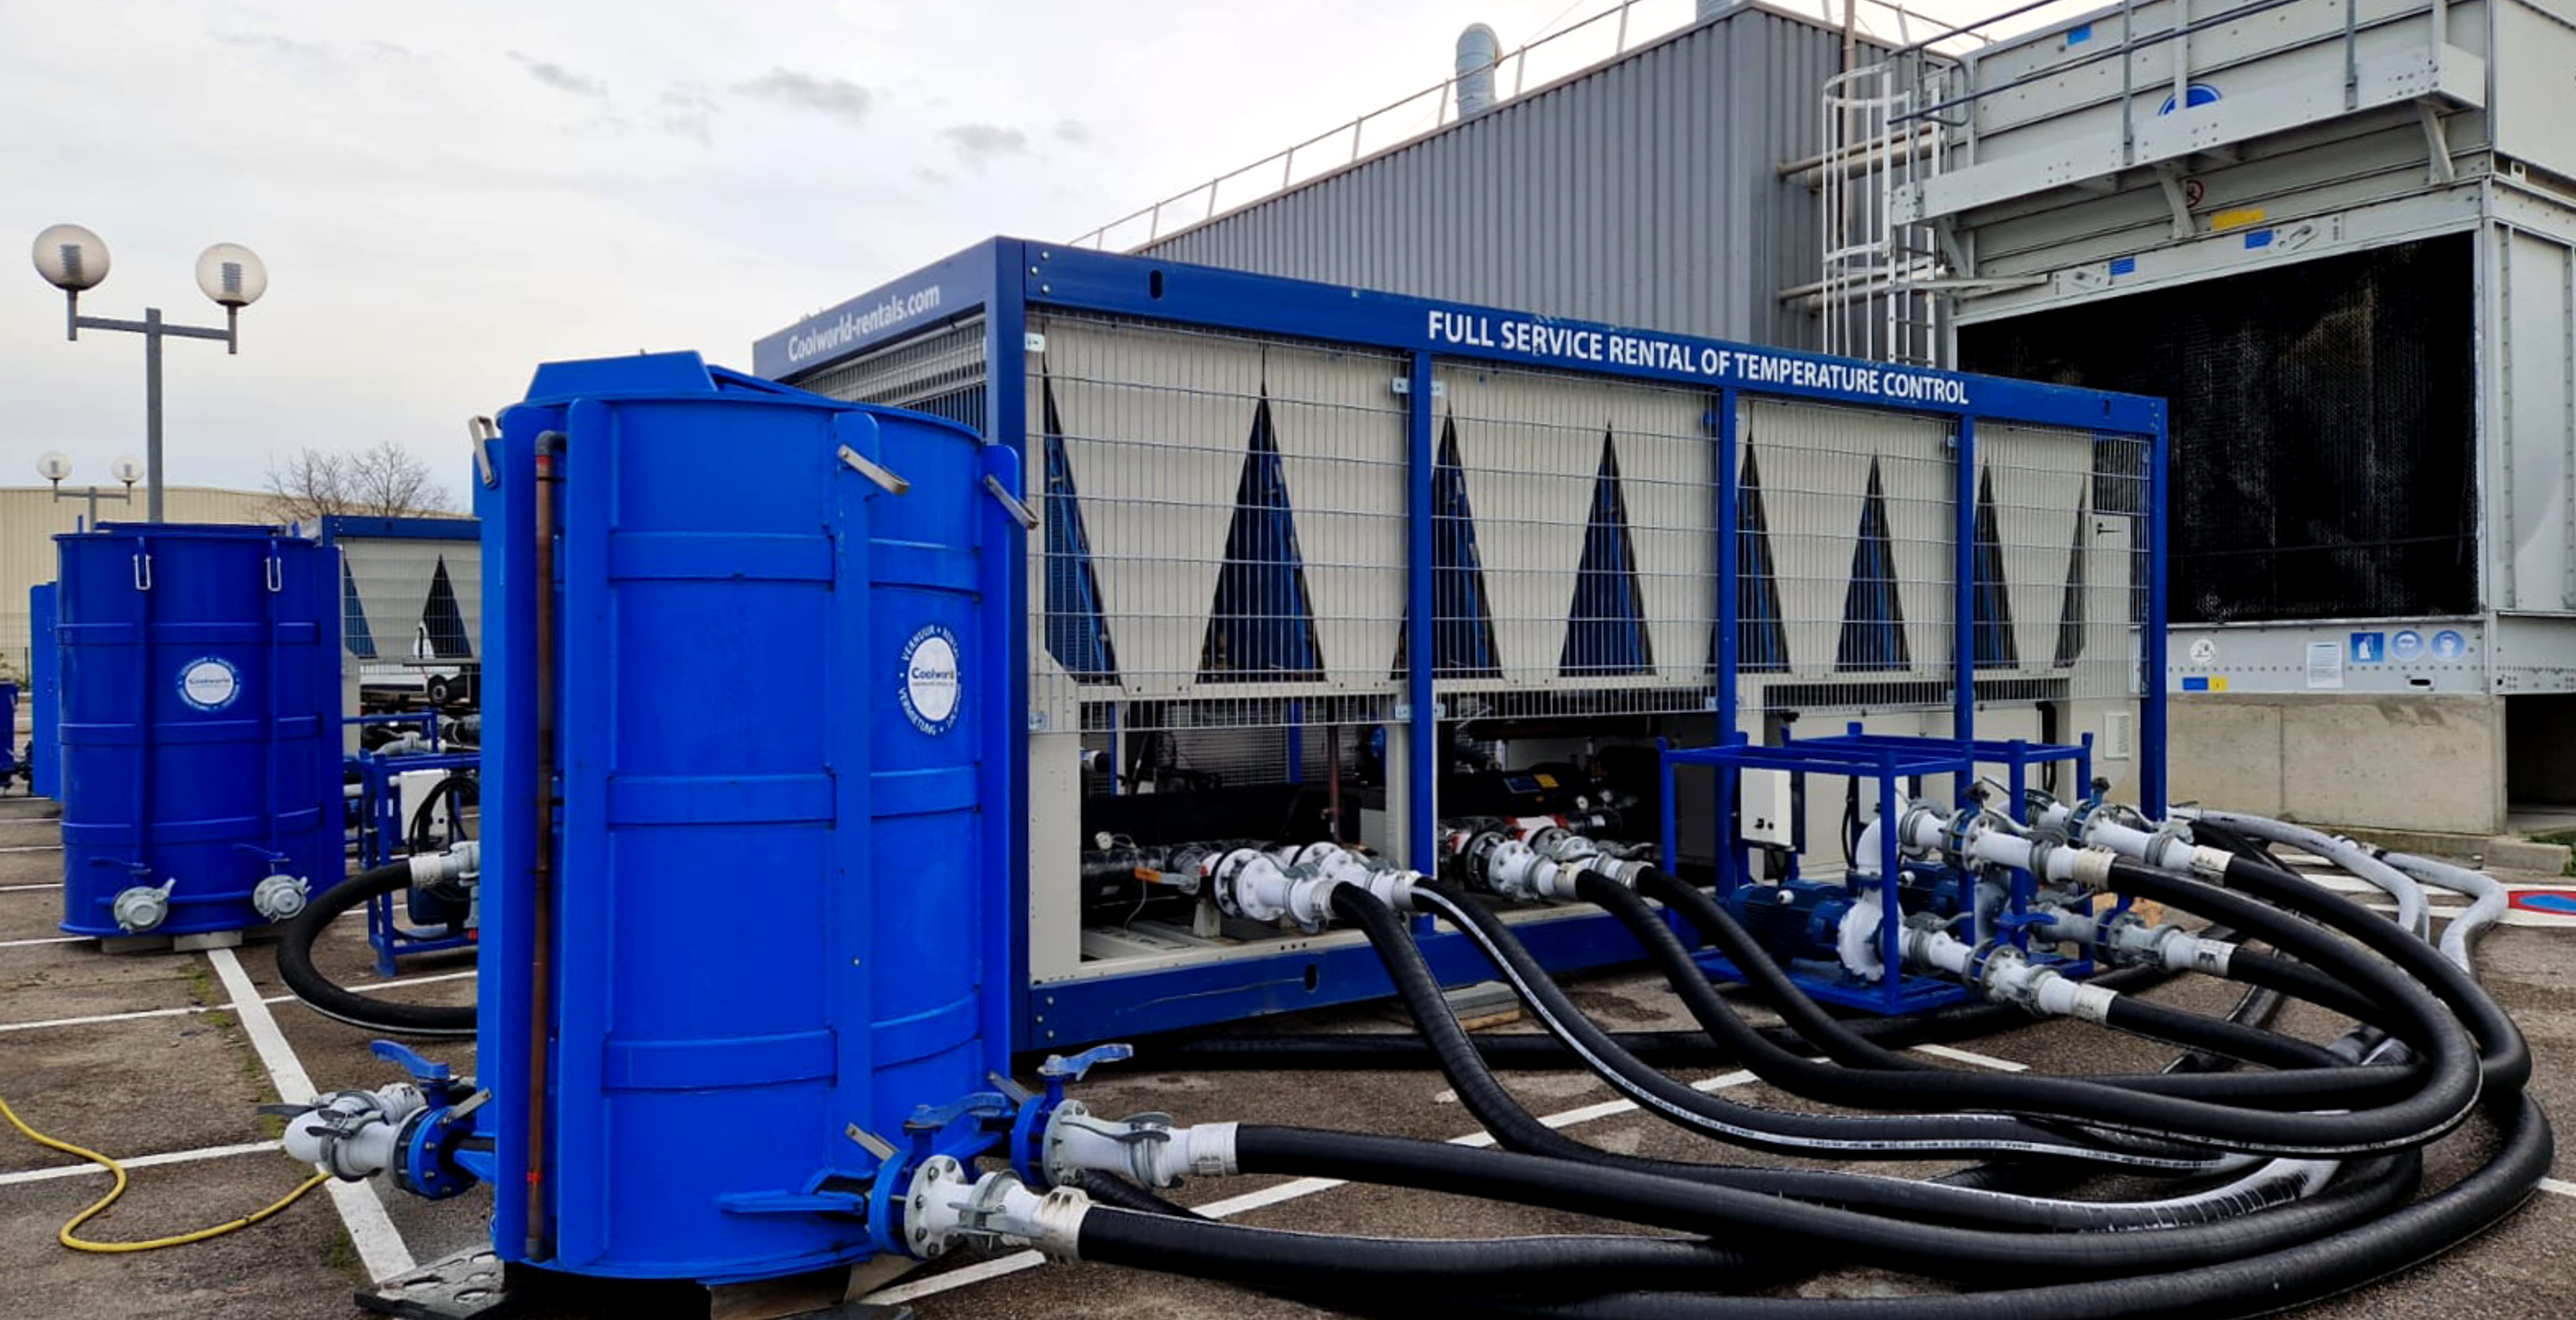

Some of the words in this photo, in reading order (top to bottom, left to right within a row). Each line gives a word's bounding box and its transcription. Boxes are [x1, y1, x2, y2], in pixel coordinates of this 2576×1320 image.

[788, 284, 941, 362] Coolworld-rentals.com
[1428, 310, 1495, 348] FULL
[1500, 320, 1603, 361] SERVICE
[1609, 335, 1696, 373] RENTAL
[1701, 348, 1731, 376] OF
[1734, 353, 1879, 395] TEMPERATURE
[1883, 372, 1970, 405] CONTROL
